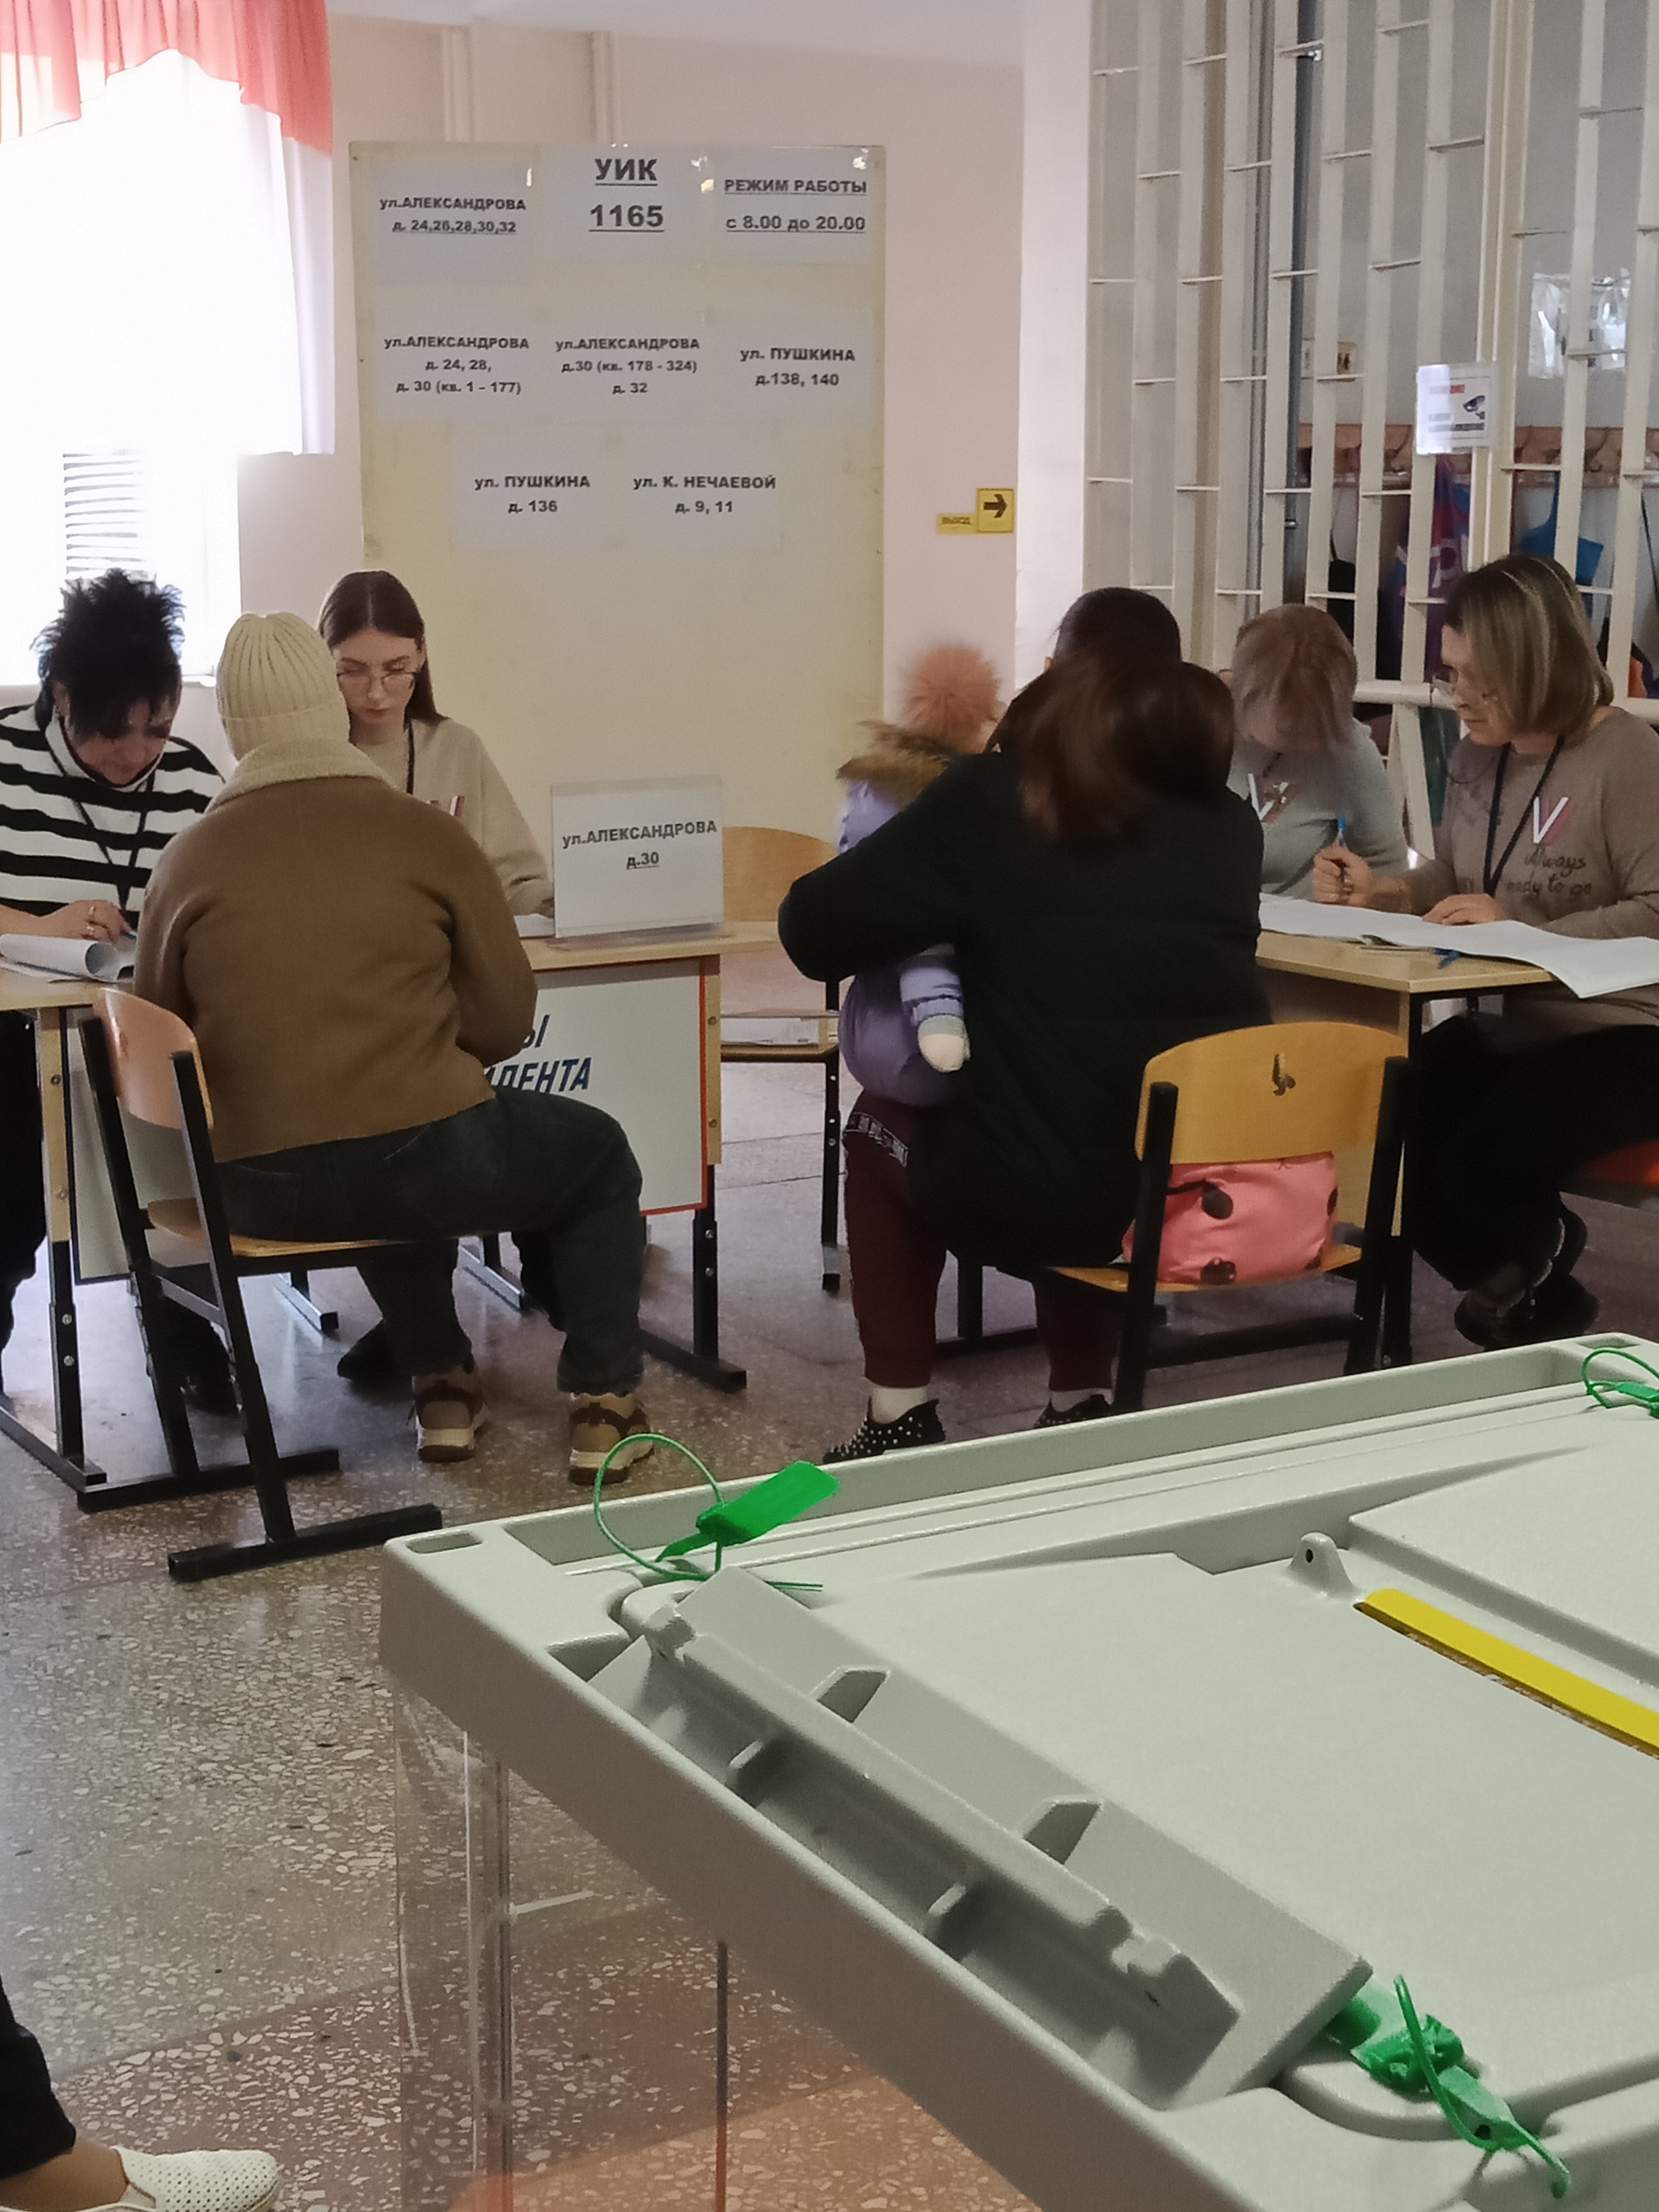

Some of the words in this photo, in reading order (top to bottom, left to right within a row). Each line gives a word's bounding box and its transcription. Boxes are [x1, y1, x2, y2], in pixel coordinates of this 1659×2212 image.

[594, 158, 657, 181] УИК
[724, 179, 789, 192] РЕЖИМ
[794, 180, 867, 192] РАБОТЫ
[380, 197, 526, 212] ул.АЛЕКСАНДРОВА
[590, 204, 664, 228] 1165
[743, 215, 782, 229] 8.00
[787, 219, 810, 231] до
[816, 215, 866, 230] 20.00
[392, 222, 406, 232] д.
[384, 336, 530, 350] ул.АЛЕКСАНДРОВА
[555, 338, 700, 353] ул.АЛЕКСАНДРОВА
[740, 350, 765, 362] ул.
[770, 347, 856, 362] ПУШКИНА
[425, 361, 439, 371] д.
[442, 359, 465, 372] 24,
[469, 359, 491, 373] 28,
[561, 360, 593, 373] д.30
[596, 361, 623, 373] (кв.
[627, 360, 653, 372] 178
[666, 360, 697, 374] 324)
[755, 372, 805, 388] д.138,
[811, 373, 839, 386] 140
[396, 383, 410, 393] д.
[414, 380, 431, 392] 30
[435, 381, 462, 395] (кв.
[466, 381, 473, 393] 1
[490, 381, 522, 396] 177)
[612, 385, 626, 395] д.
[630, 382, 648, 394] 32
[474, 479, 499, 491] ул.
[505, 475, 590, 488] ПУШКИНА
[633, 478, 658, 490] ул.
[663, 475, 678, 488] К.
[684, 474, 776, 489] НЕЧАЕВОЙ
[508, 503, 523, 514] д.
[528, 500, 558, 513] 136
[675, 503, 690, 514] д.
[695, 500, 710, 515] 9,
[715, 500, 733, 513] 11
[562, 819, 717, 849] ул.АЛЕКСАНДРОВА
[626, 851, 659, 868] д.30
[485, 1057, 591, 1093] ДЕНТА
